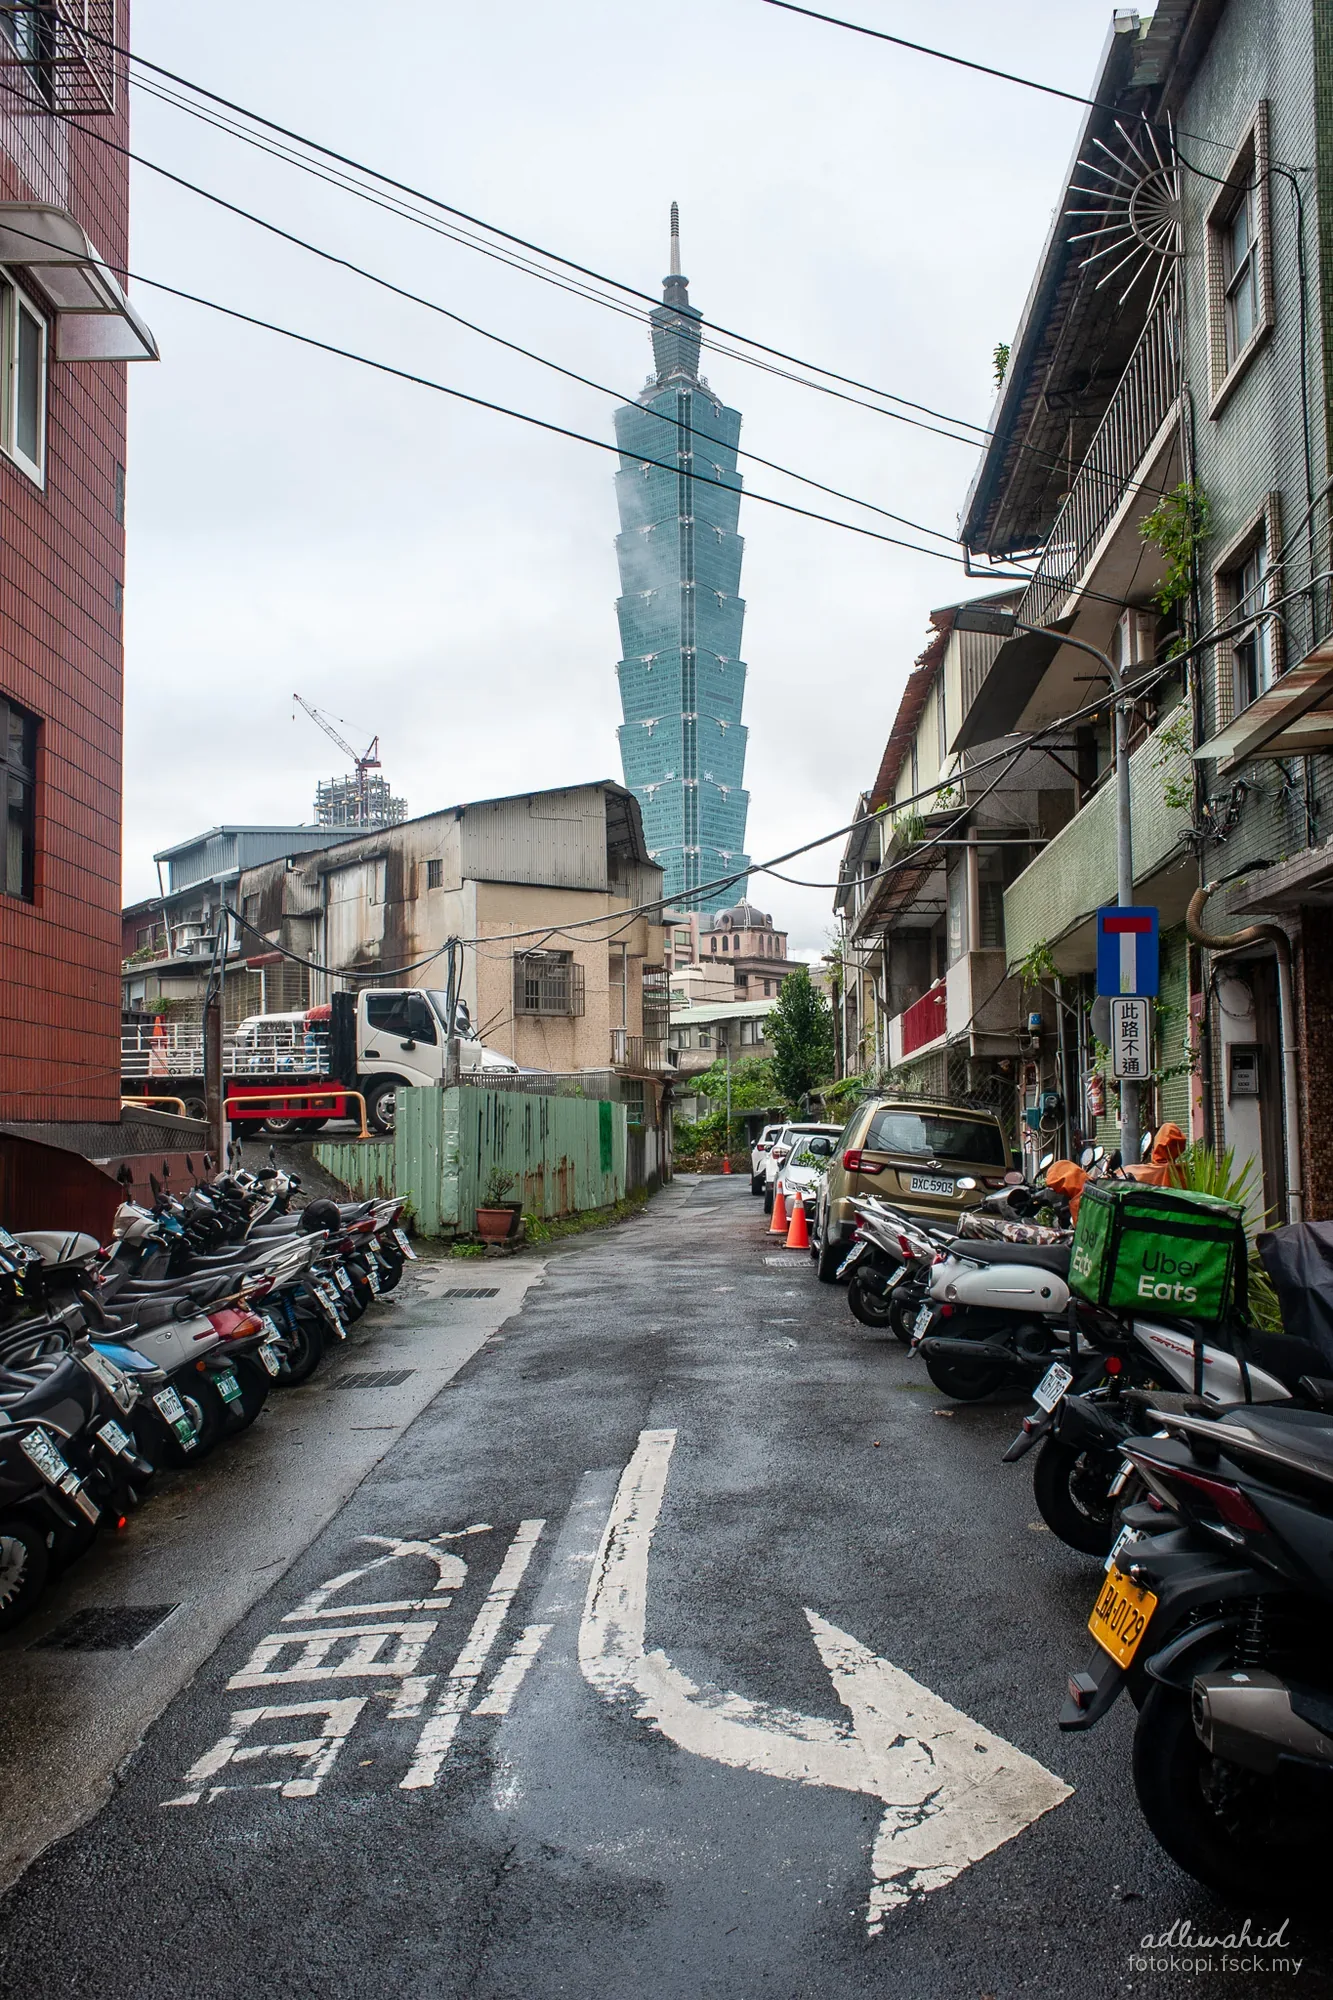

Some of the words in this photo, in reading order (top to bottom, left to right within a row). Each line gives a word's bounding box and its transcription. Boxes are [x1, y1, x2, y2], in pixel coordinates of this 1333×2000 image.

[1121, 1002, 1140, 1075] 此路不通
[912, 1178, 953, 1194] BXC-5903
[1142, 1250, 1203, 1277] Uber
[1137, 1275, 1198, 1303] Eats
[1095, 1581, 1145, 1647] LBA-0129
